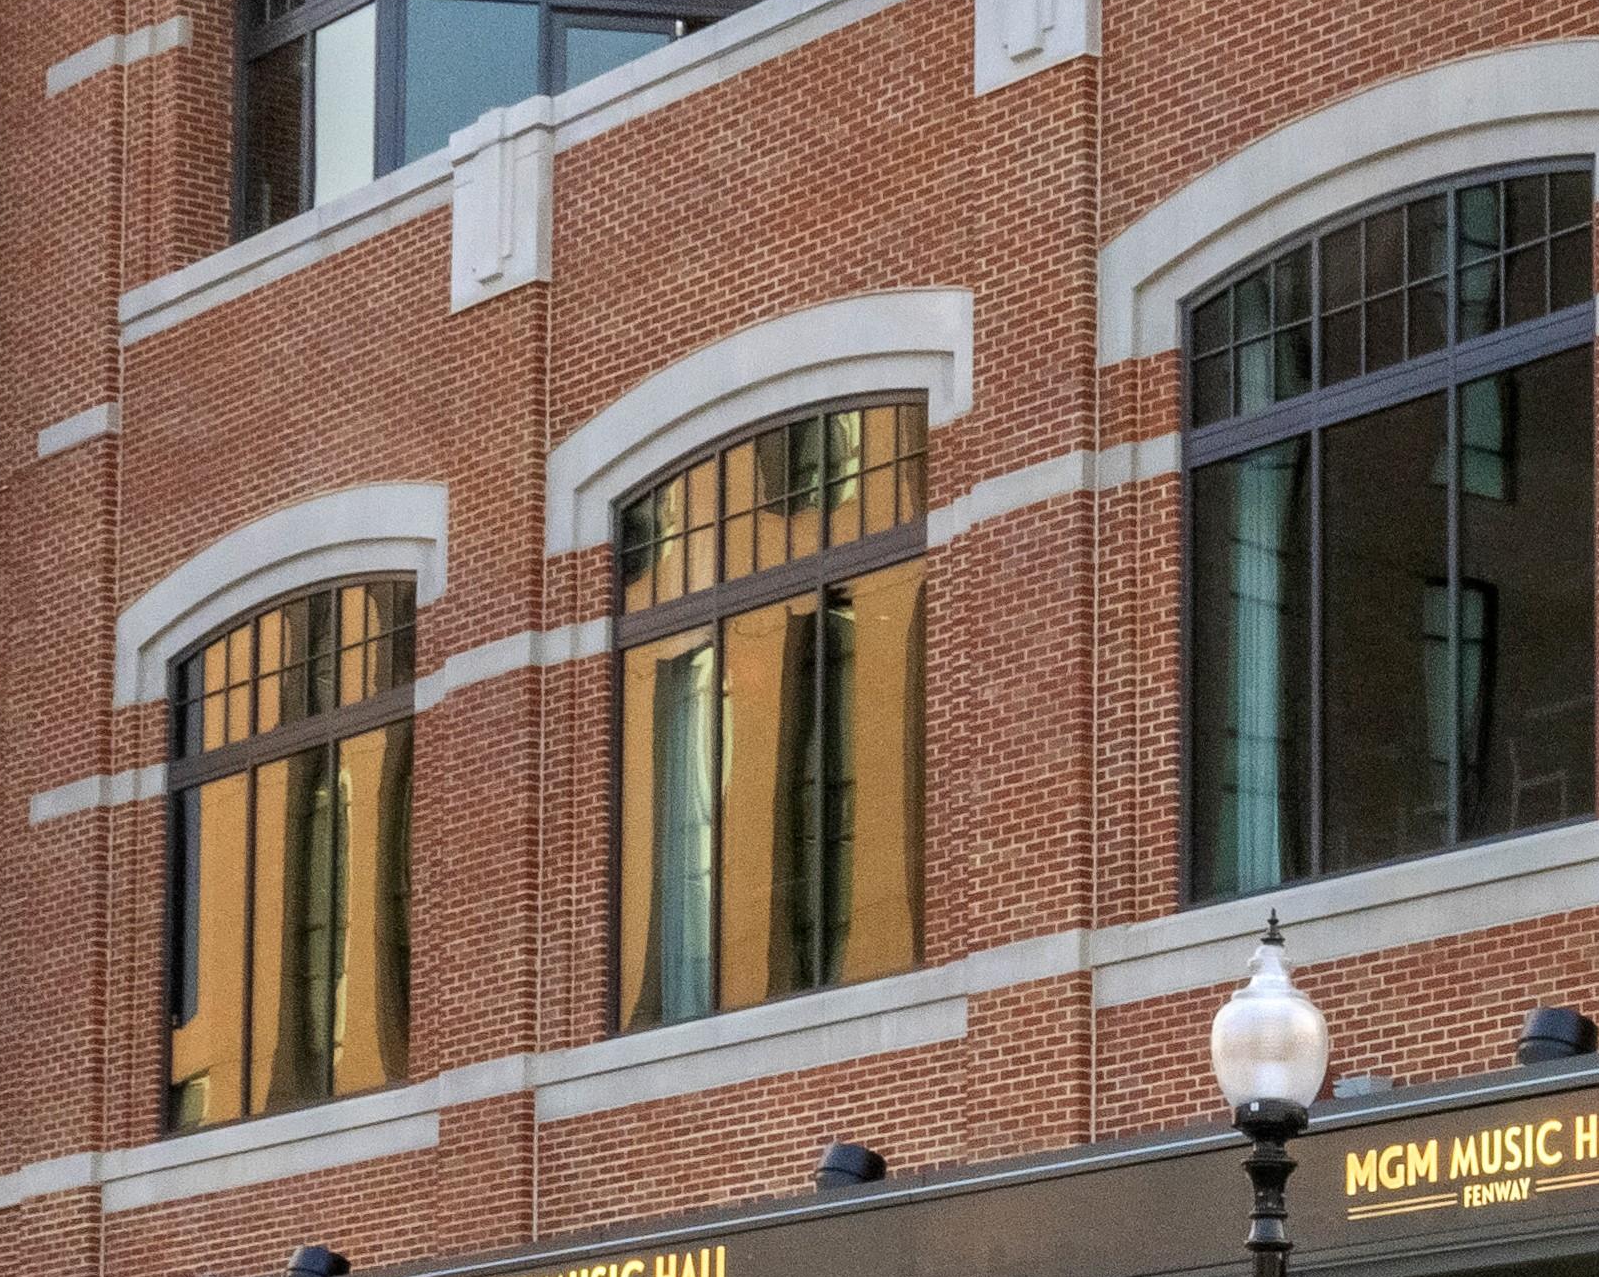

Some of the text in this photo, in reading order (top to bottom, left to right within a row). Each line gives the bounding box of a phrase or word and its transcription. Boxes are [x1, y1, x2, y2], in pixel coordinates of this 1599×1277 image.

[1346, 1138, 1439, 1196] MGM
[1449, 1119, 1563, 1180] MUSIC
[1463, 1177, 1531, 1208] FENWAY
